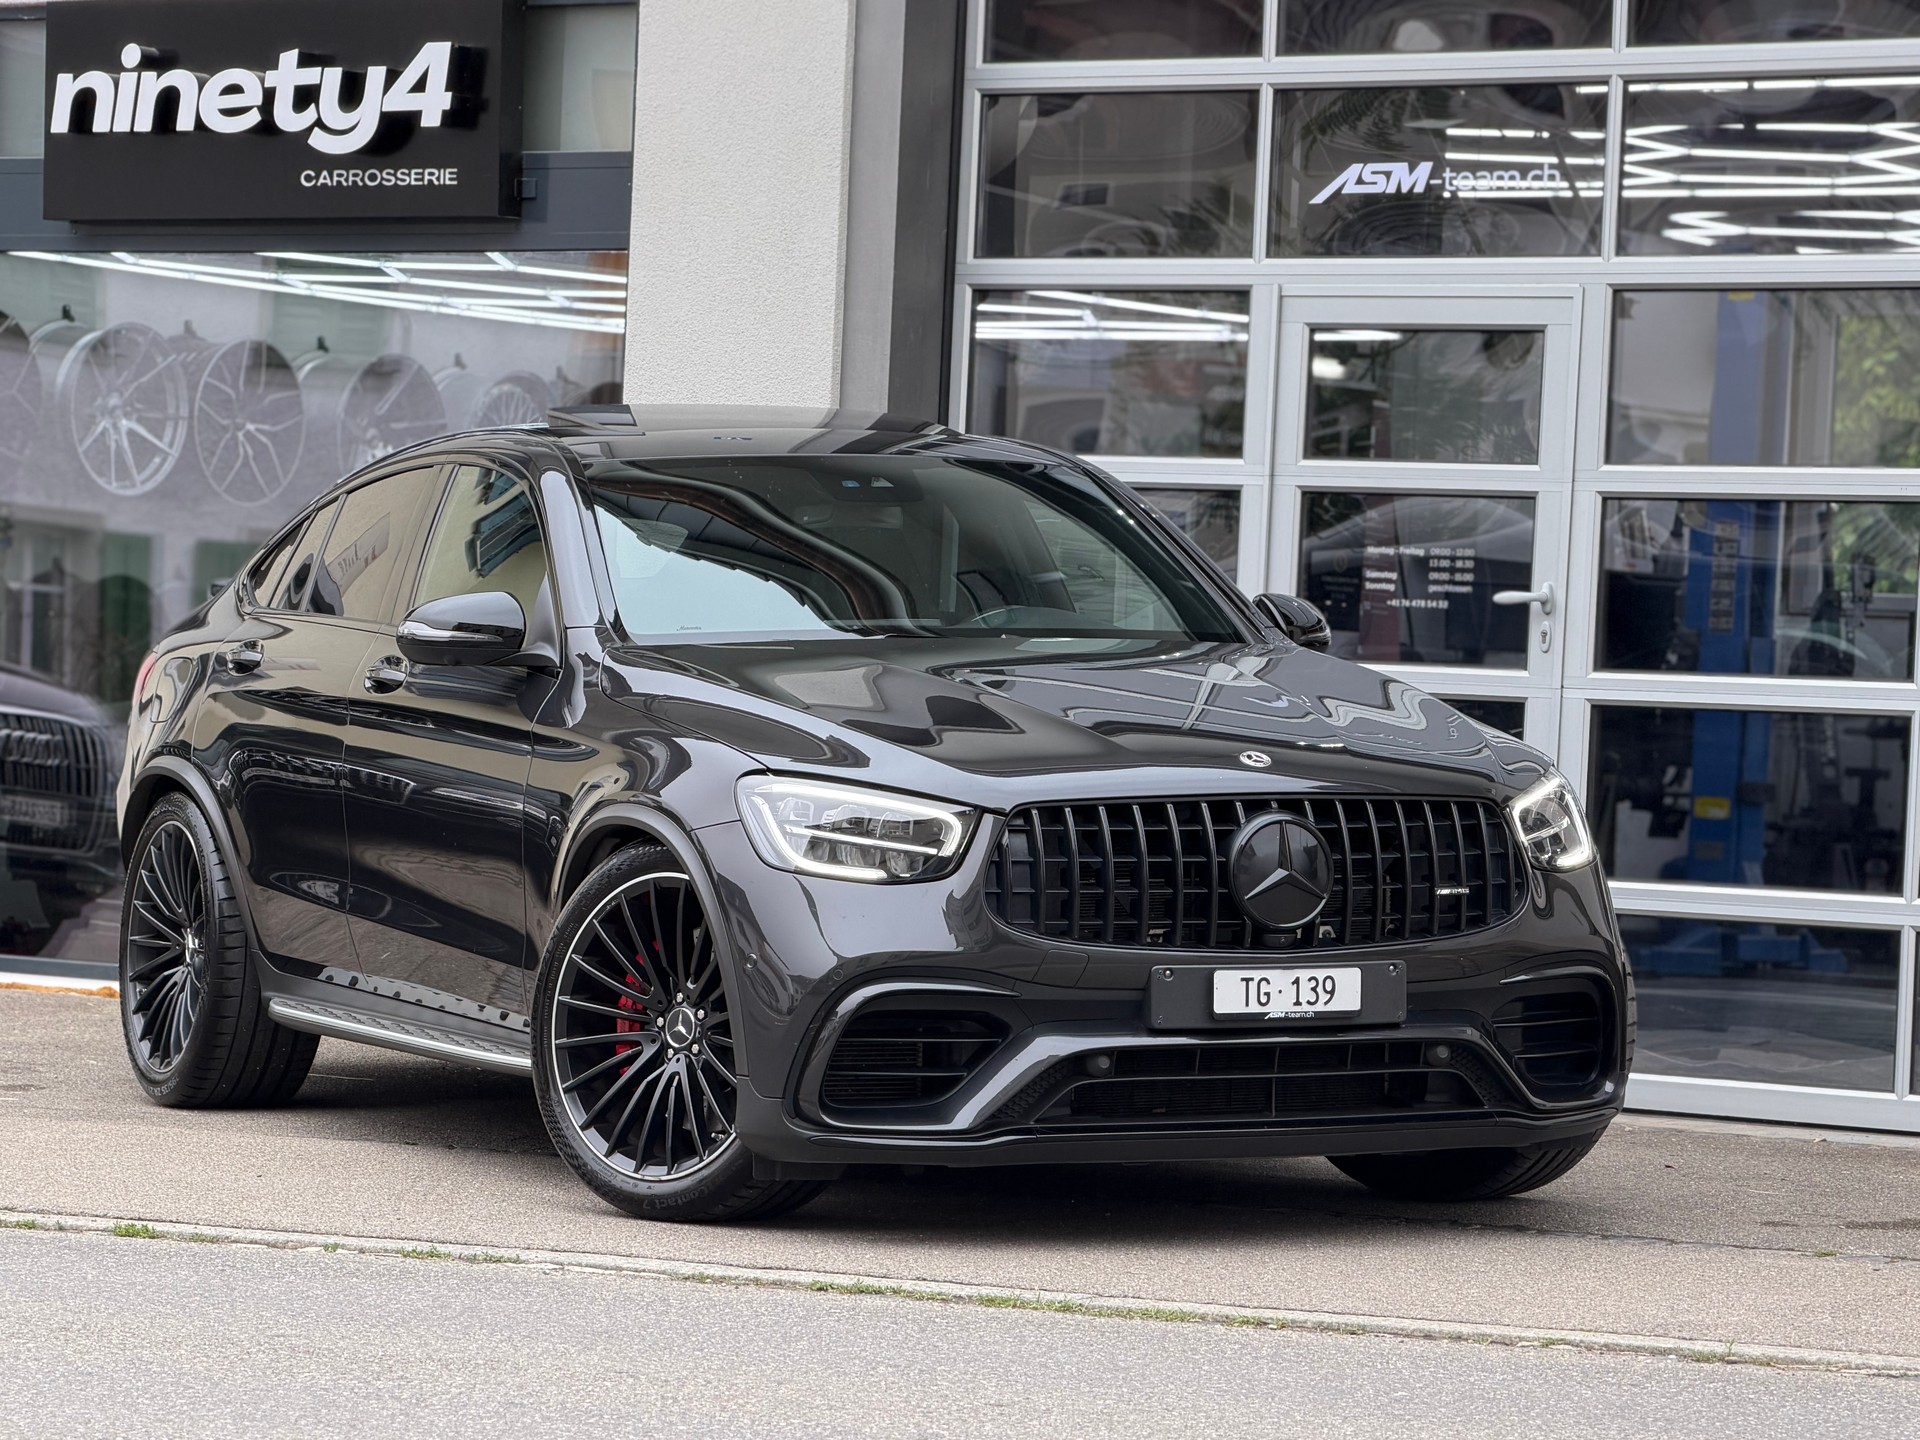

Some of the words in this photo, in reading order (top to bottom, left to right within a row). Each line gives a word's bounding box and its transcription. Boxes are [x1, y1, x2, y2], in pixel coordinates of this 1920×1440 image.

[50, 42, 453, 154] ninety4
[300, 168, 458, 187] CARROSSERIE
[1365, 581, 1395, 591] Sonntag
[1240, 977, 1271, 1007] TG
[1291, 974, 1337, 1007] 139
